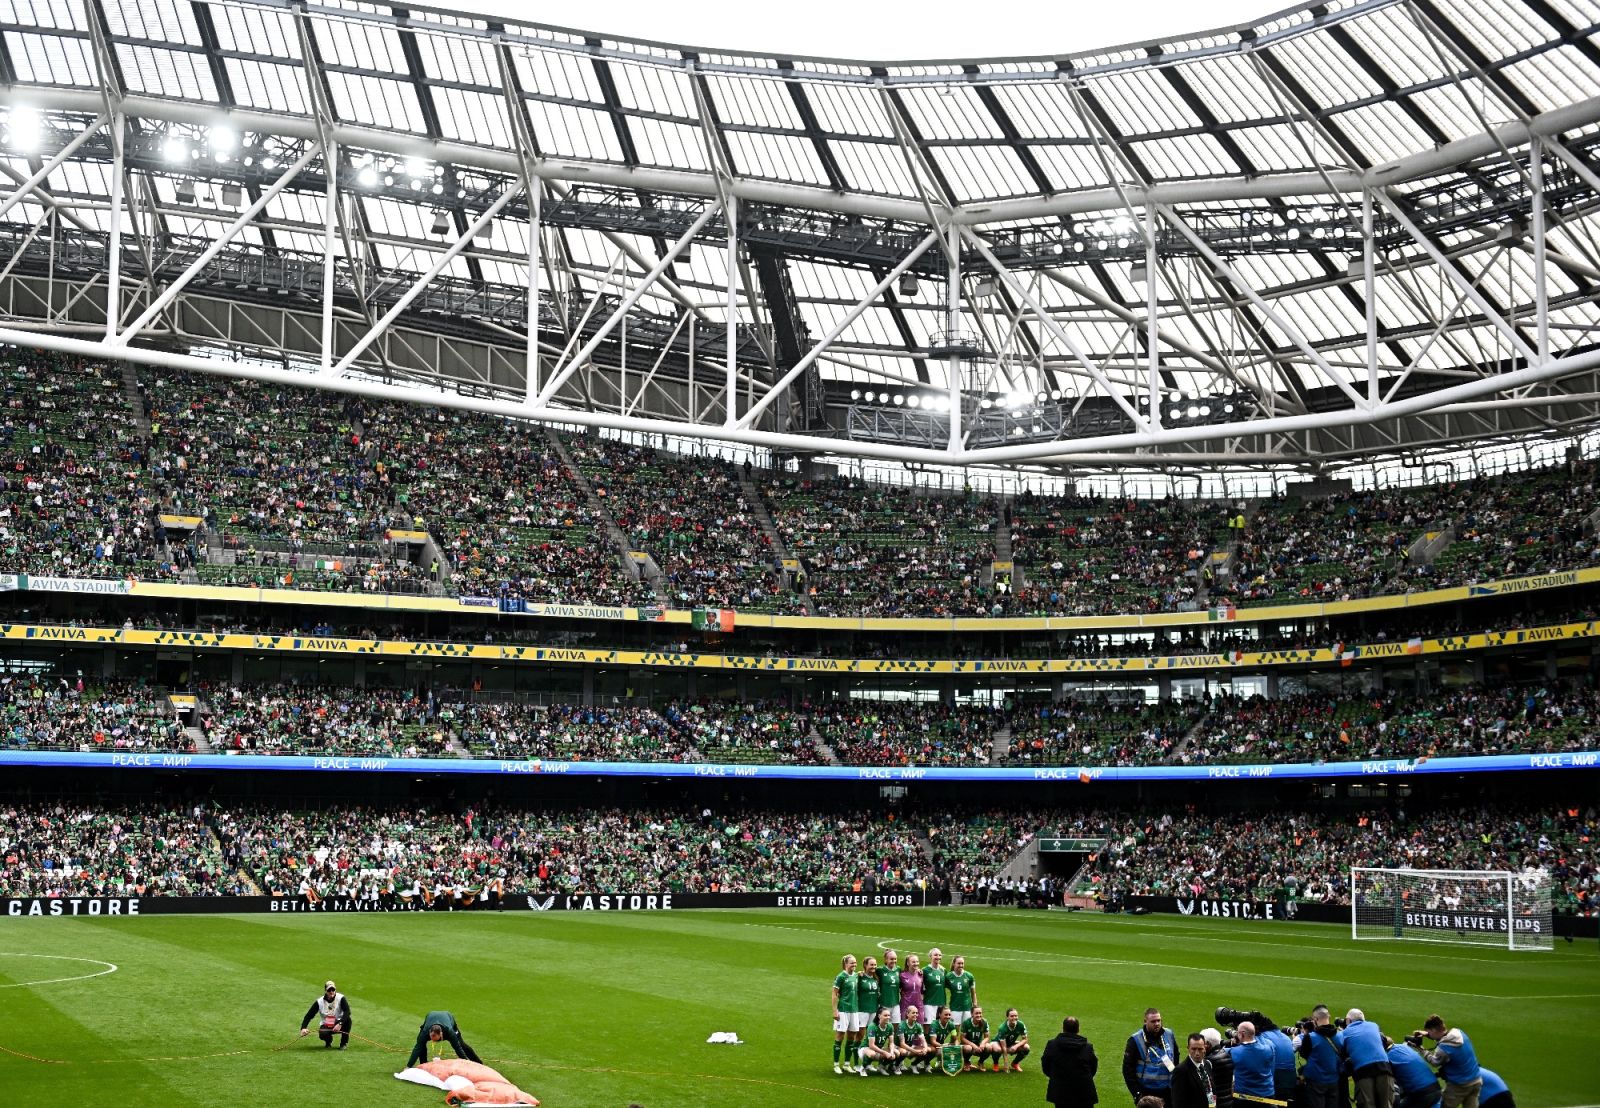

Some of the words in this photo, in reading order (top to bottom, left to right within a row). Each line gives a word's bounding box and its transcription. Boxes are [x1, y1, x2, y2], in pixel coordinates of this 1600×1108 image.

[32, 579, 70, 590] AVIVA
[1501, 579, 1530, 592] AVIVA
[1532, 573, 1576, 588] STADIUM
[543, 606, 575, 616] AVIVA
[577, 608, 623, 618] STADIUM
[40, 628, 86, 639] AVIVA
[1528, 627, 1564, 640] AVIVA
[306, 639, 348, 650] AVIVA
[1365, 644, 1403, 656] AVIVA
[548, 650, 586, 660] AVIVA
[1179, 655, 1220, 666] AVIVA
[799, 659, 838, 669] AVIVA
[987, 661, 1028, 671] AVIVA
[112, 754, 151, 766] PEACE
[163, 756, 192, 766] МИР
[314, 758, 349, 769] PEACE
[361, 760, 388, 770] МИР
[1530, 756, 1562, 767] PEACE
[1572, 754, 1597, 766] МИР
[501, 762, 534, 772] PEACE
[544, 763, 570, 773] МИР
[694, 766, 725, 775] PEACE
[735, 767, 758, 776] МИР
[859, 768, 891, 778] PEACE
[901, 769, 926, 778] МИР
[1209, 767, 1239, 777] PEACE
[1249, 767, 1273, 777] МИР
[1362, 763, 1388, 773] PEACE
[1034, 769, 1067, 778] PEACE
[778, 896, 824, 906] BETTER
[874, 895, 912, 905] STOPS
[8, 899, 139, 916] CASTORE
[1406, 913, 1449, 927] BETTER
[1454, 915, 1494, 930] NEVER
[890, 975, 896, 984] 5
[957, 981, 963, 990] 6
